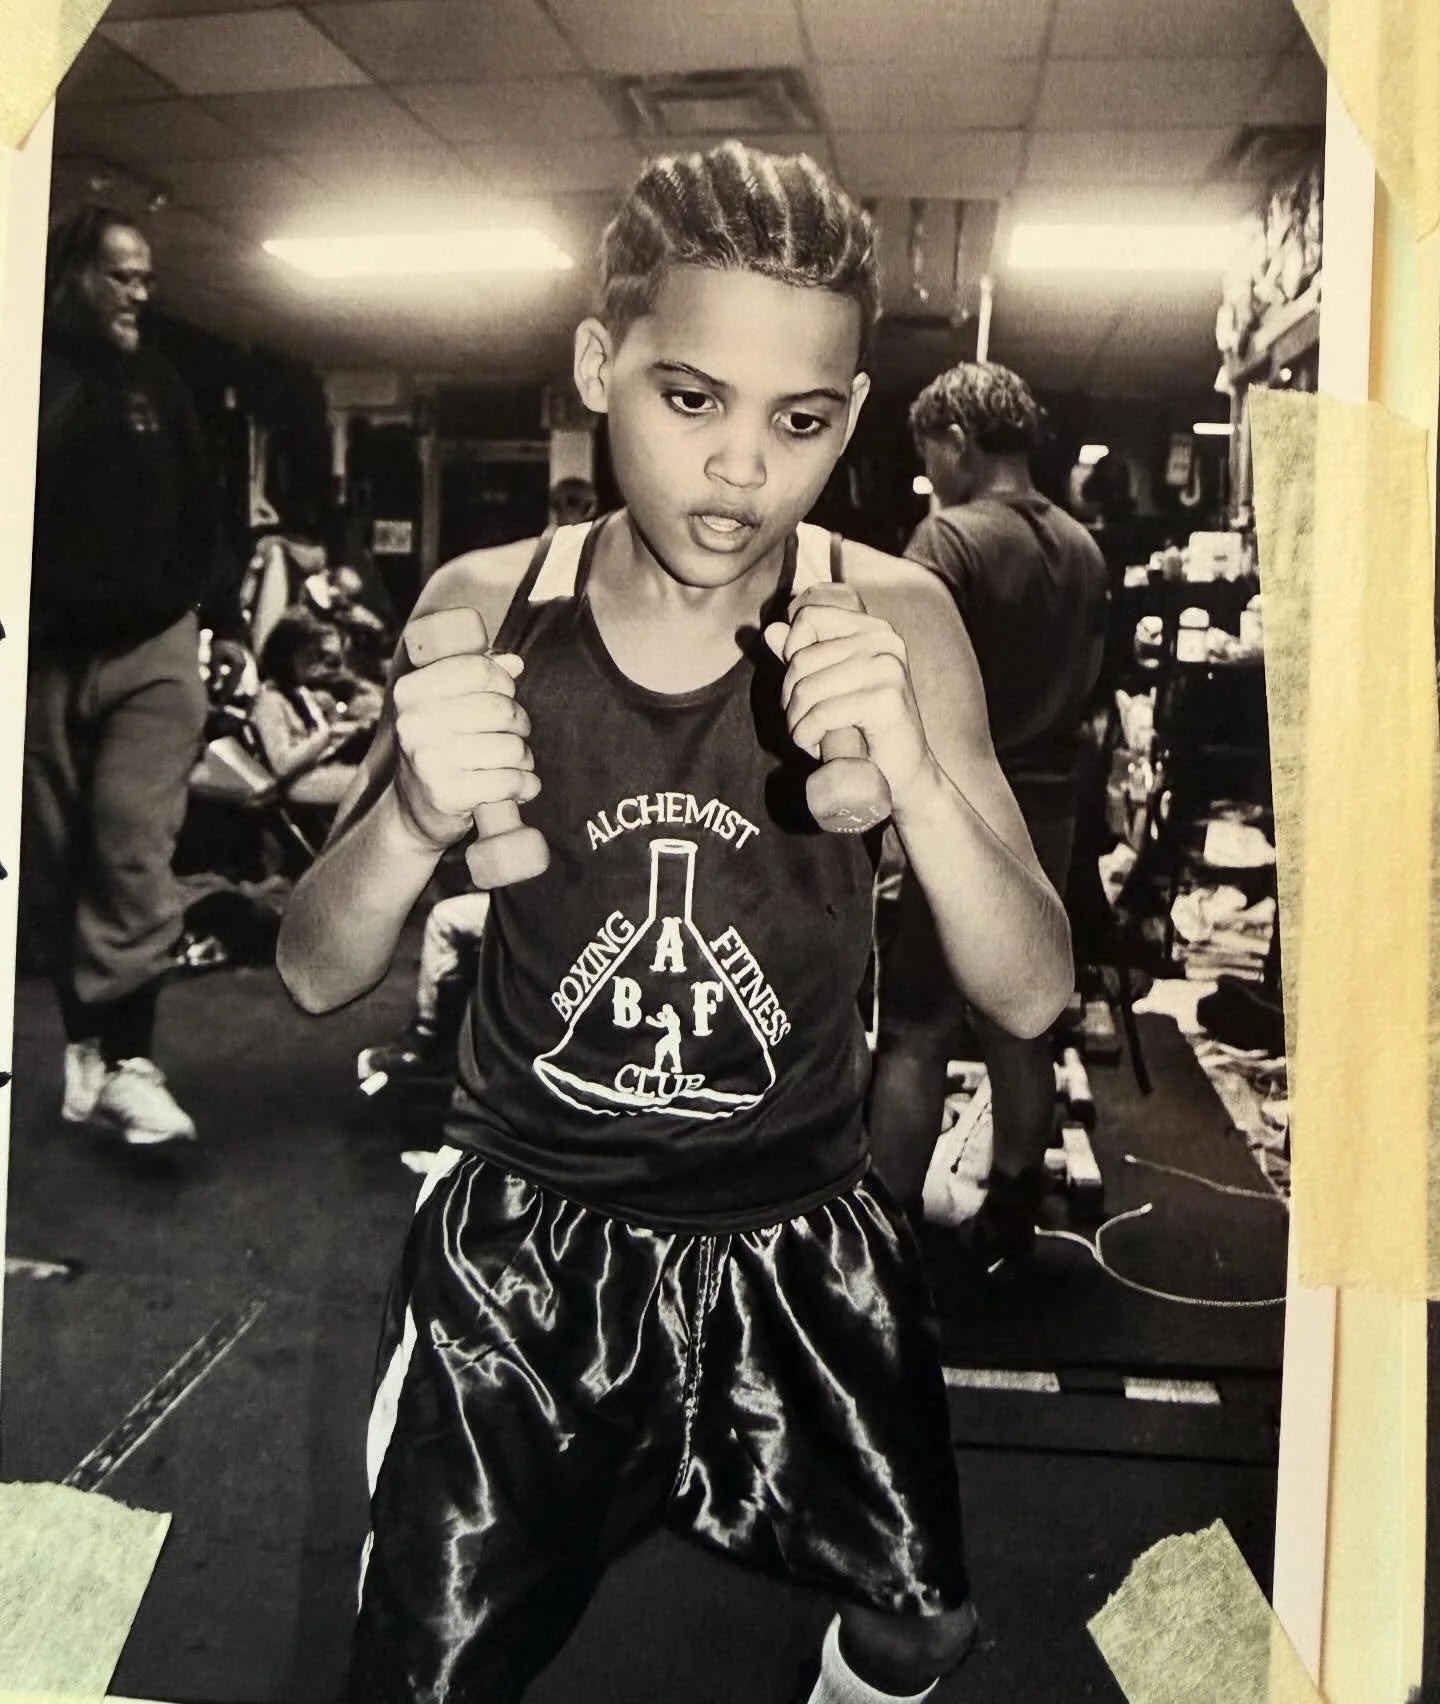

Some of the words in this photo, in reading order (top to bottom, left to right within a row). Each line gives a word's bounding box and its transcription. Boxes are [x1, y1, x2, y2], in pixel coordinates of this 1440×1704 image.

[586, 791, 760, 850] ALCHEMIST
[550, 910, 635, 1021] BOXING
[649, 916, 687, 973] A
[612, 976, 642, 1029] B
[690, 981, 723, 1037] F
[709, 925, 792, 1046] FITNESS
